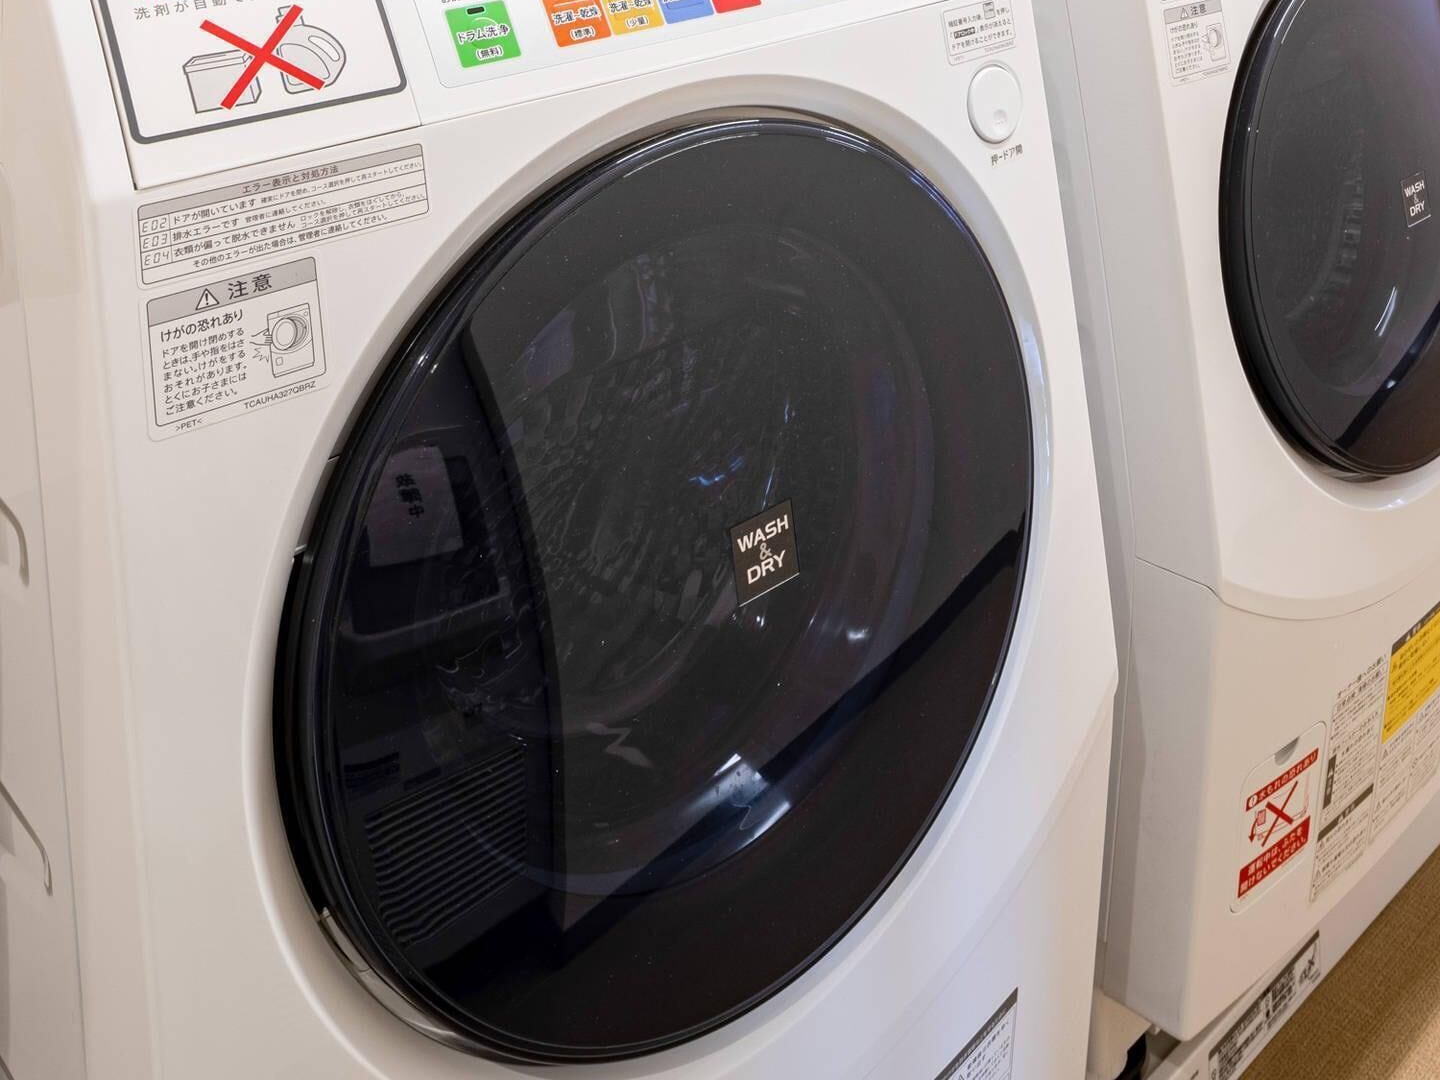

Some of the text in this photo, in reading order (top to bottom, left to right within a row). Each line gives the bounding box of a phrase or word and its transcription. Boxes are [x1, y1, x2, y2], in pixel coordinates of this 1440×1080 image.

[456, 24, 510, 44] ドラム洗浄
[241, 164, 339, 195] エラー表示と対処方法
[1403, 179, 1425, 198] WASH
[172, 198, 257, 226] ドアが開いています
[1409, 200, 1425, 217] DRY
[141, 218, 168, 234] E02
[171, 219, 241, 243] 排水エラーです
[173, 221, 297, 259] 衣類が偏って脱水できません
[142, 234, 169, 250] E03
[143, 250, 171, 267] E04
[227, 272, 273, 301] 注意
[160, 308, 244, 343] けがの恐れあり
[161, 326, 245, 359] ドアを開け閉めする
[162, 338, 246, 371] ときは、手や指をはさ
[164, 363, 248, 394] おそれがあります。
[164, 373, 248, 405] とくにお子さまには
[165, 389, 238, 416] ご注意ください。
[736, 513, 790, 553] WASH
[759, 542, 773, 560] &
[746, 549, 786, 585] DRY
